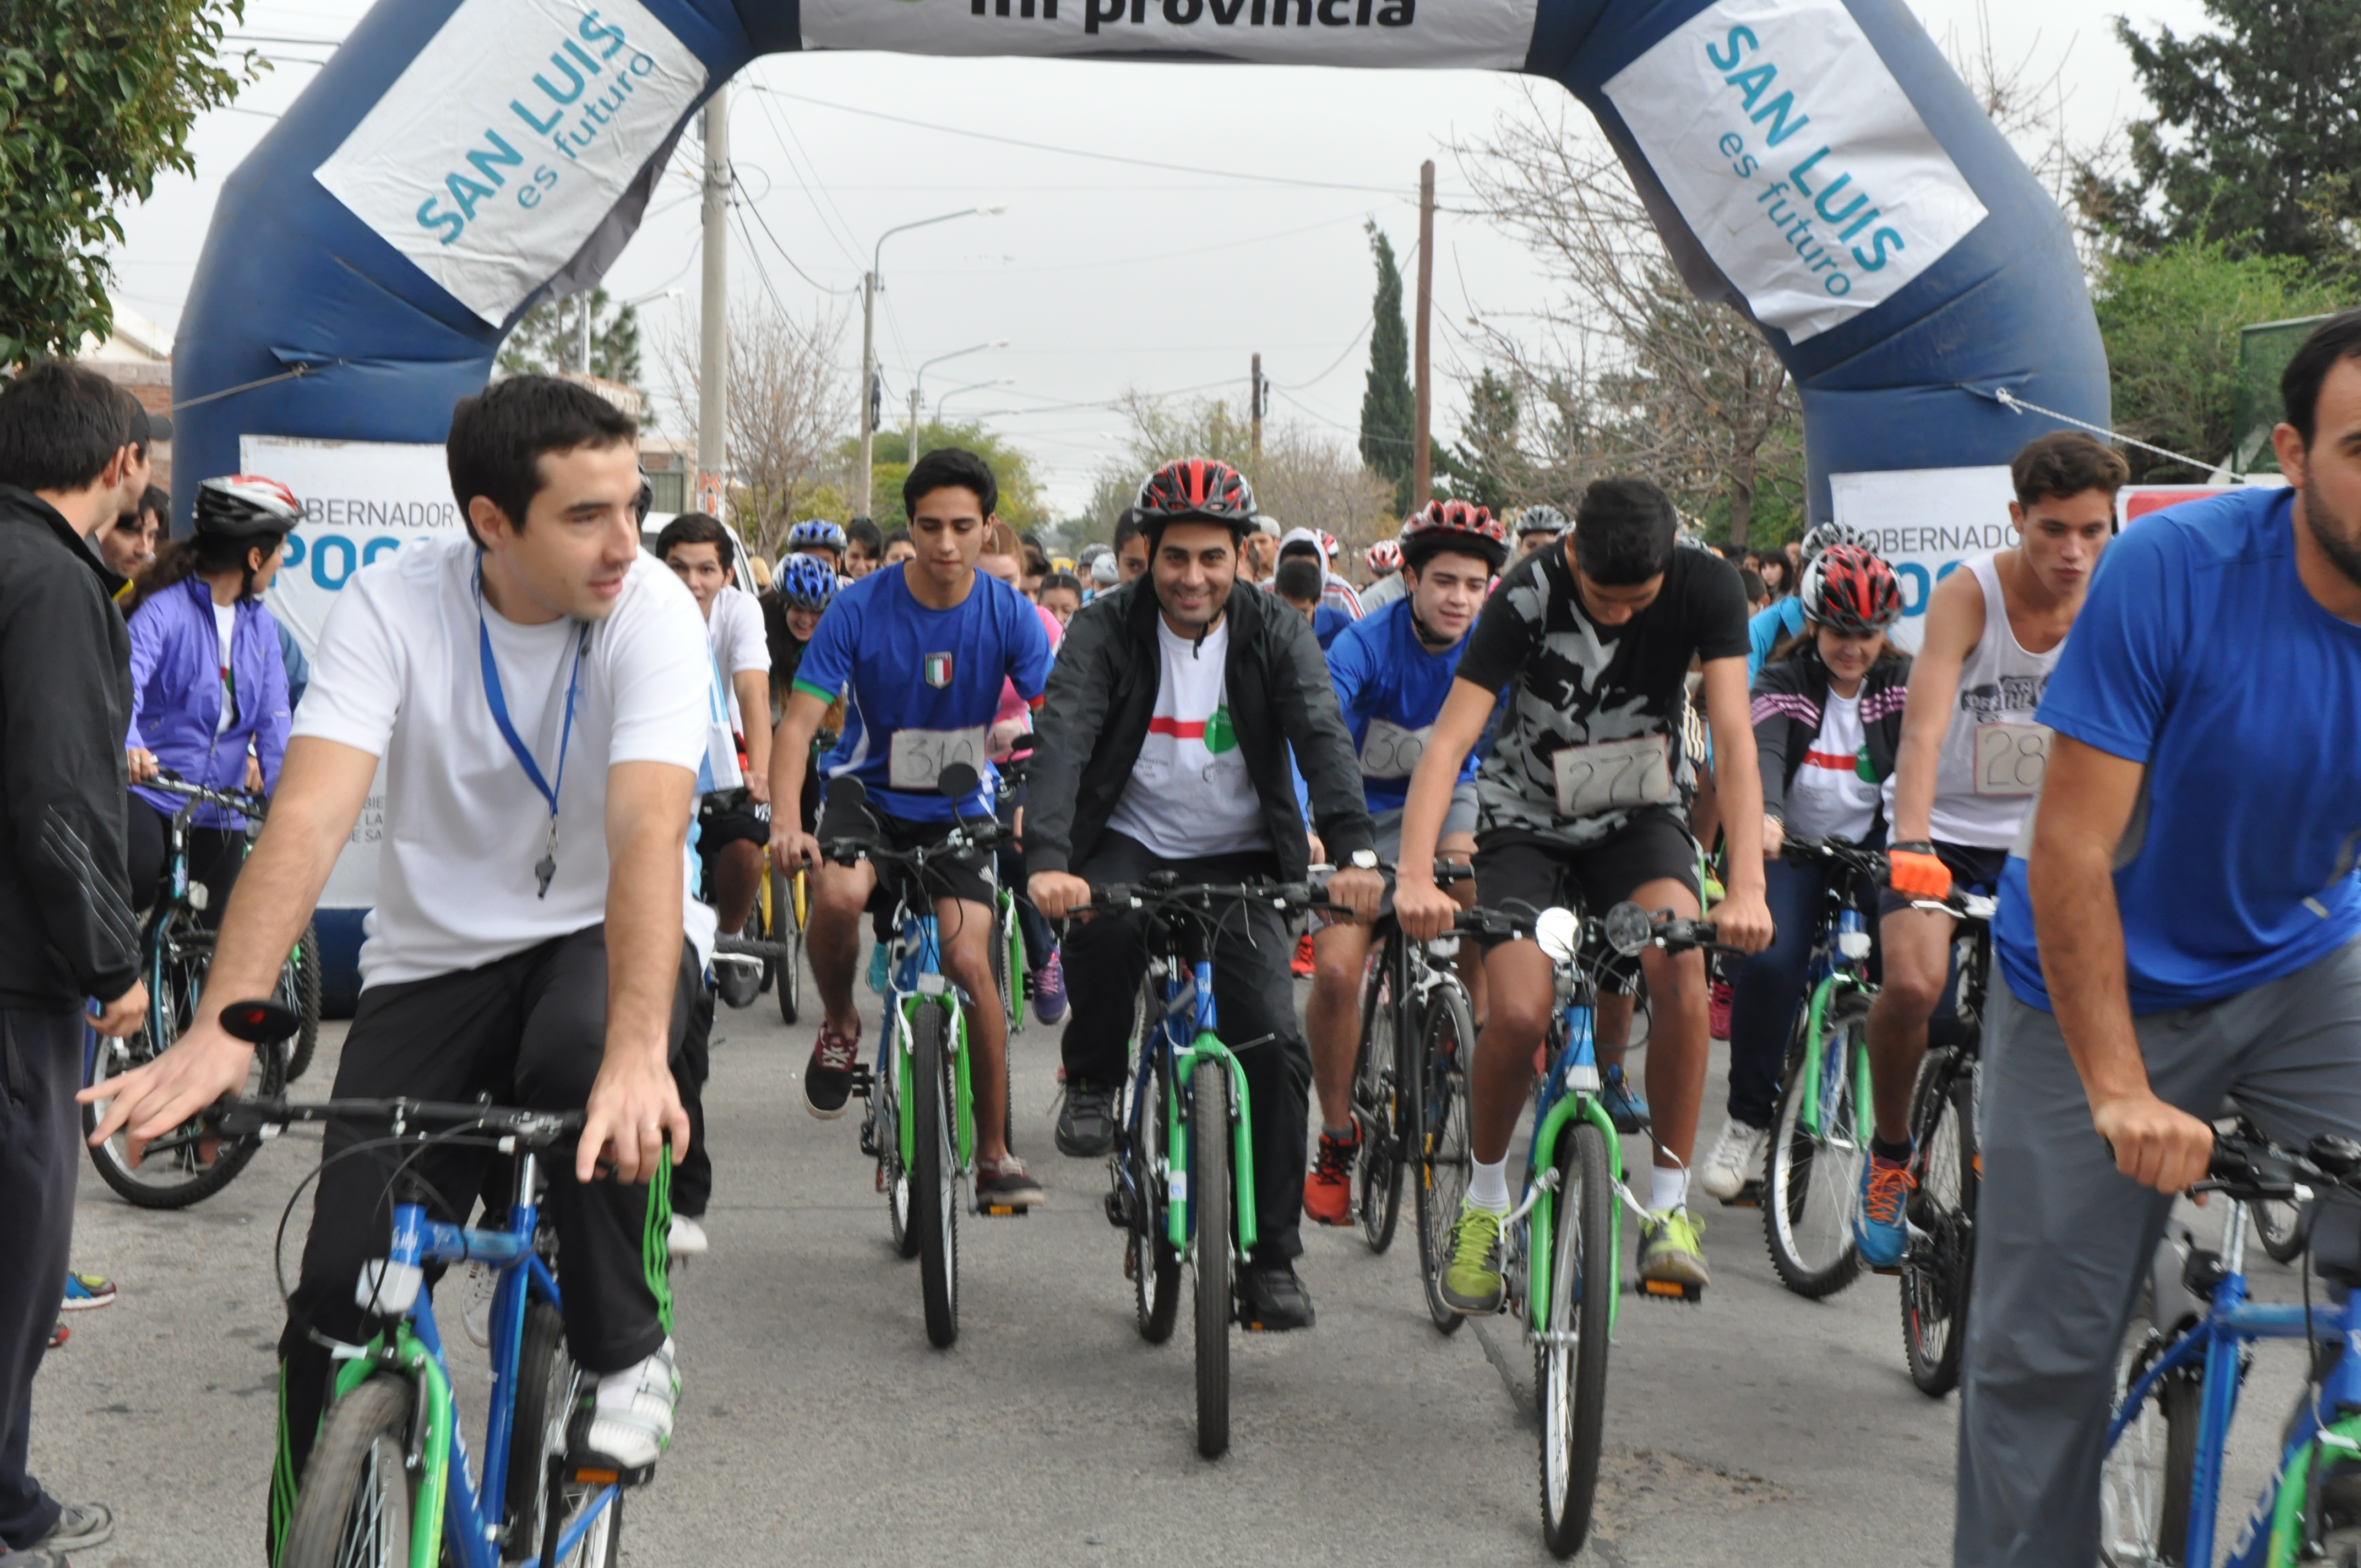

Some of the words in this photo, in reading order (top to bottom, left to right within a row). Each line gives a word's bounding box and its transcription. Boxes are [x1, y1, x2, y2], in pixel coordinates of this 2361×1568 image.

[417, 128, 524, 246] SAN
[510, 9, 625, 135] LUIS
[518, 165, 557, 209] es
[553, 53, 654, 159] futuro
[1706, 25, 1810, 148] SAN
[1789, 145, 1905, 273] LUIS
[1719, 132, 1759, 178] es
[1757, 182, 1851, 297] futuro
